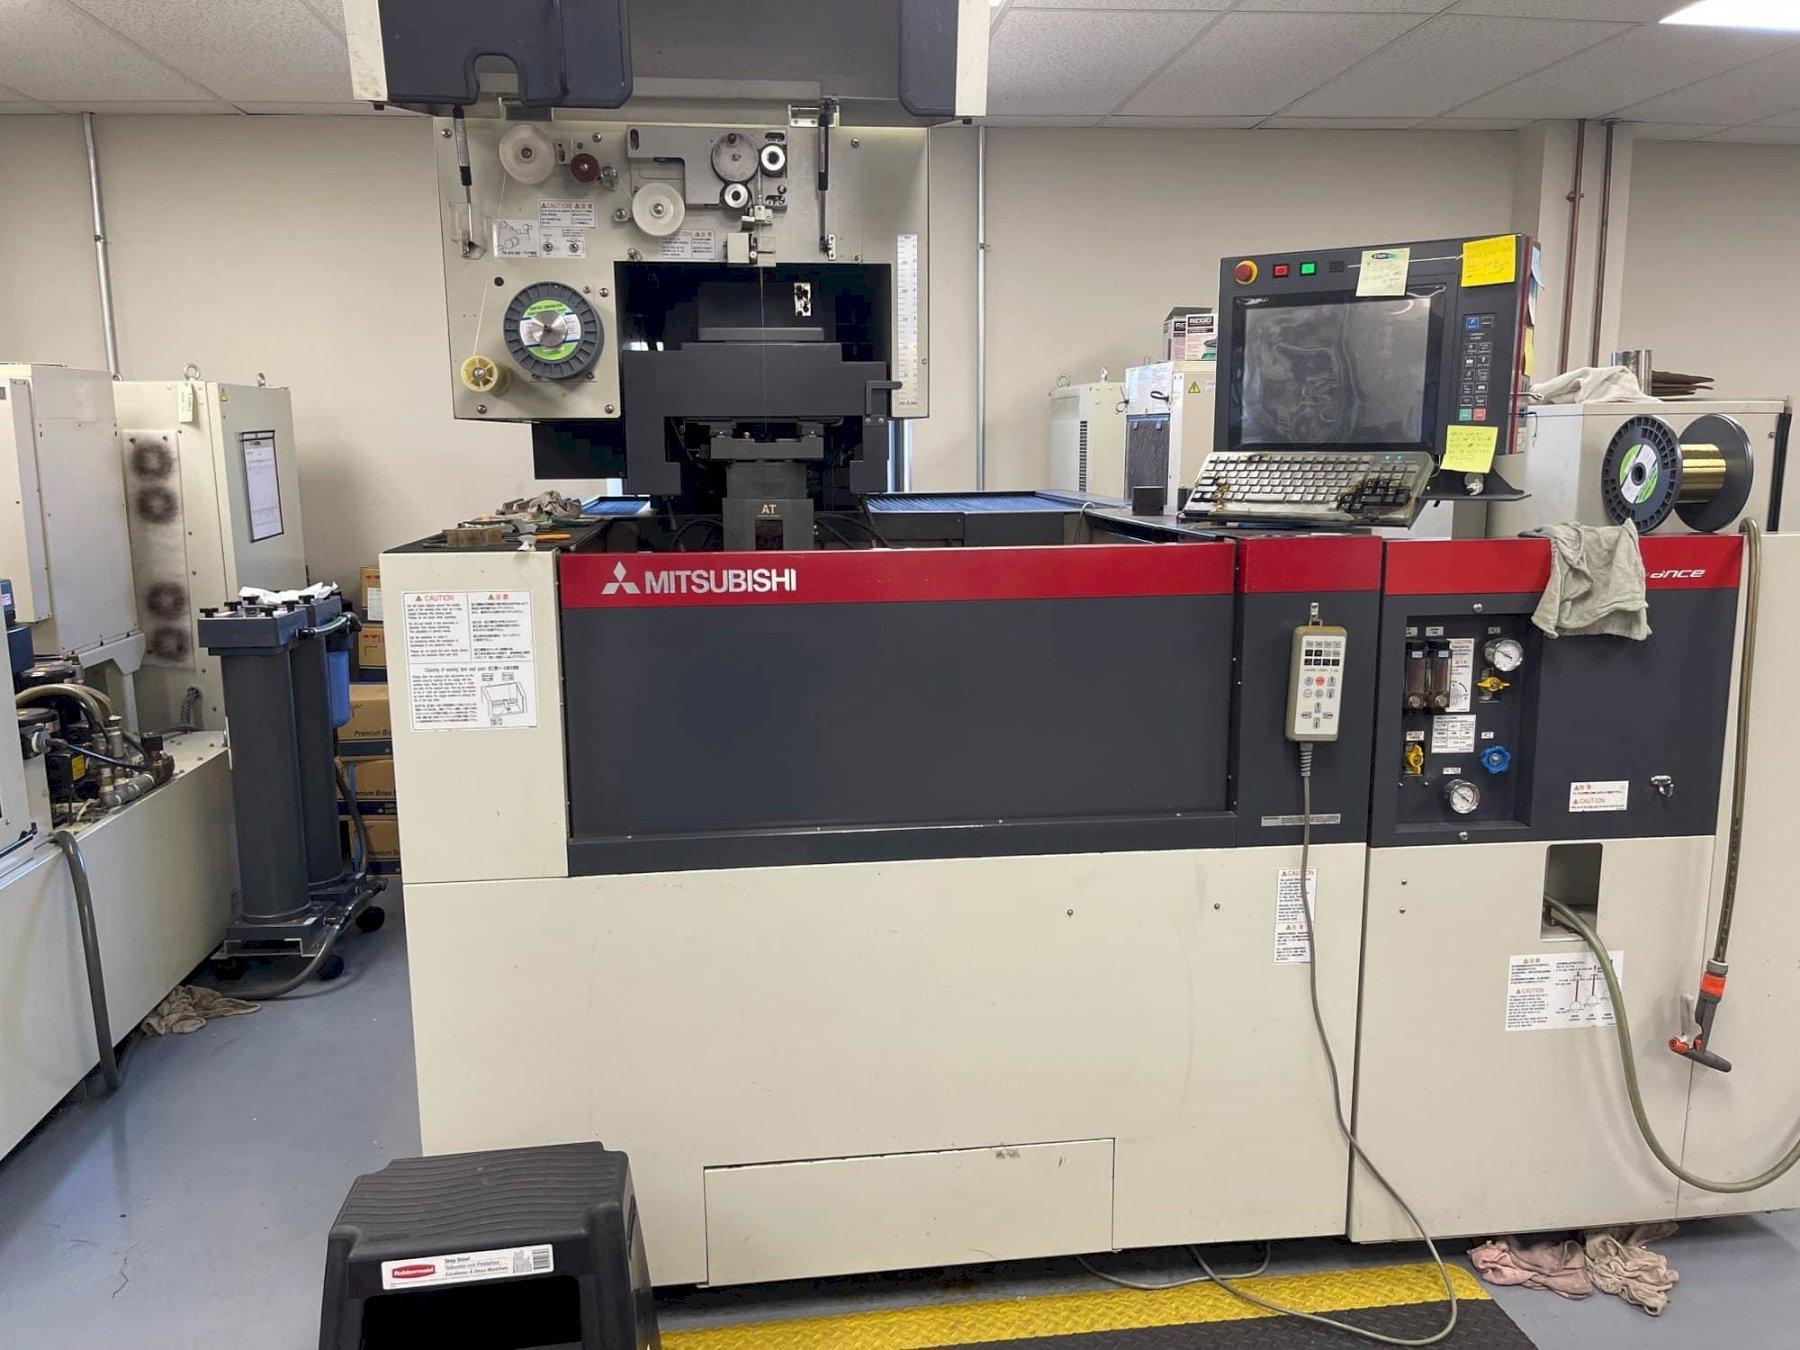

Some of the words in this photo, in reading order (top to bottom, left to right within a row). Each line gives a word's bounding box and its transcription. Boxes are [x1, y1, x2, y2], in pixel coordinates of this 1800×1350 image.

[761, 504, 777, 514] AT
[1649, 569, 1706, 579] ance
[645, 568, 797, 594] MITSUBISHI
